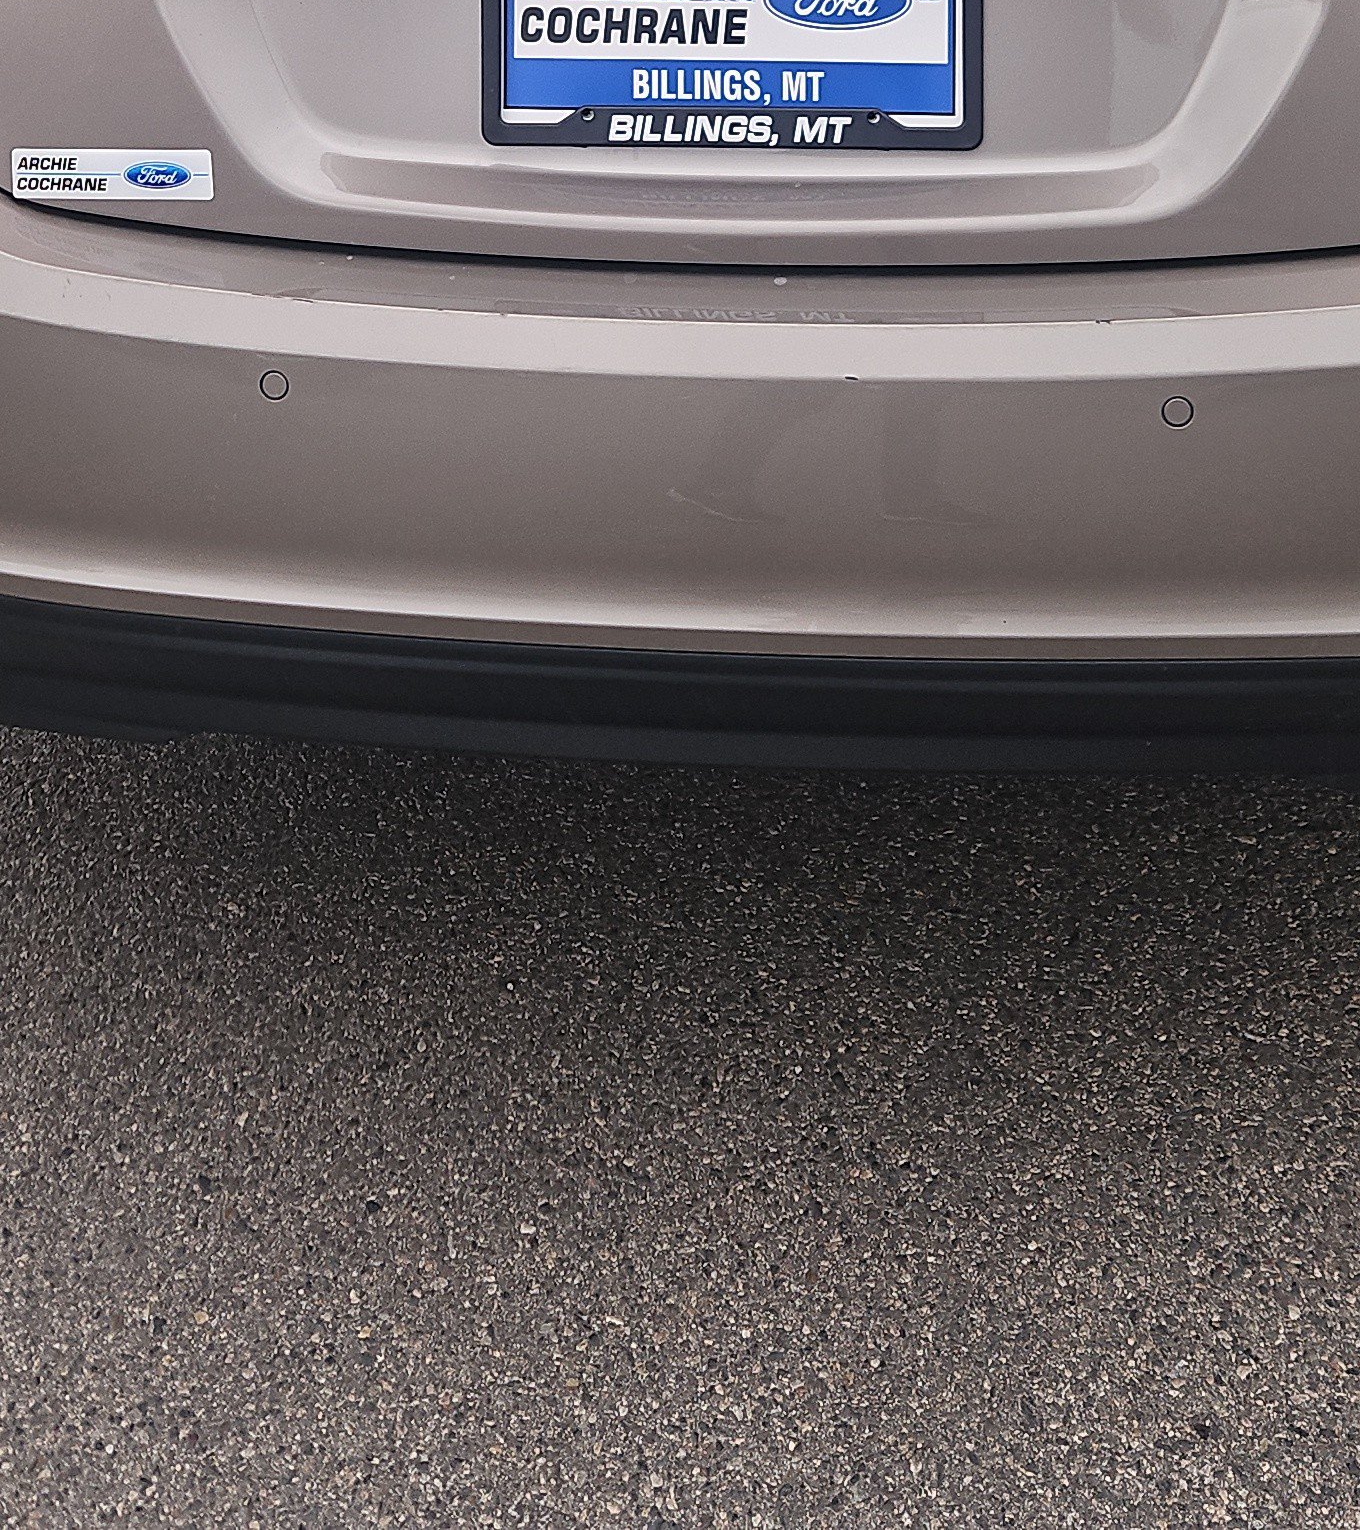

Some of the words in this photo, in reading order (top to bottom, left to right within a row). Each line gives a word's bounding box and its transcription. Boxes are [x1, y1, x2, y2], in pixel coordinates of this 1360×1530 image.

[520, 8, 748, 45] COCHRANE
[632, 69, 771, 106] BILLINGS,
[782, 71, 825, 102] MT
[608, 115, 779, 147] BILLINGS,
[793, 118, 853, 144] MT
[17, 157, 77, 171] ARCHIE
[137, 165, 177, 184] Ford
[16, 177, 108, 192] COCHRANE
